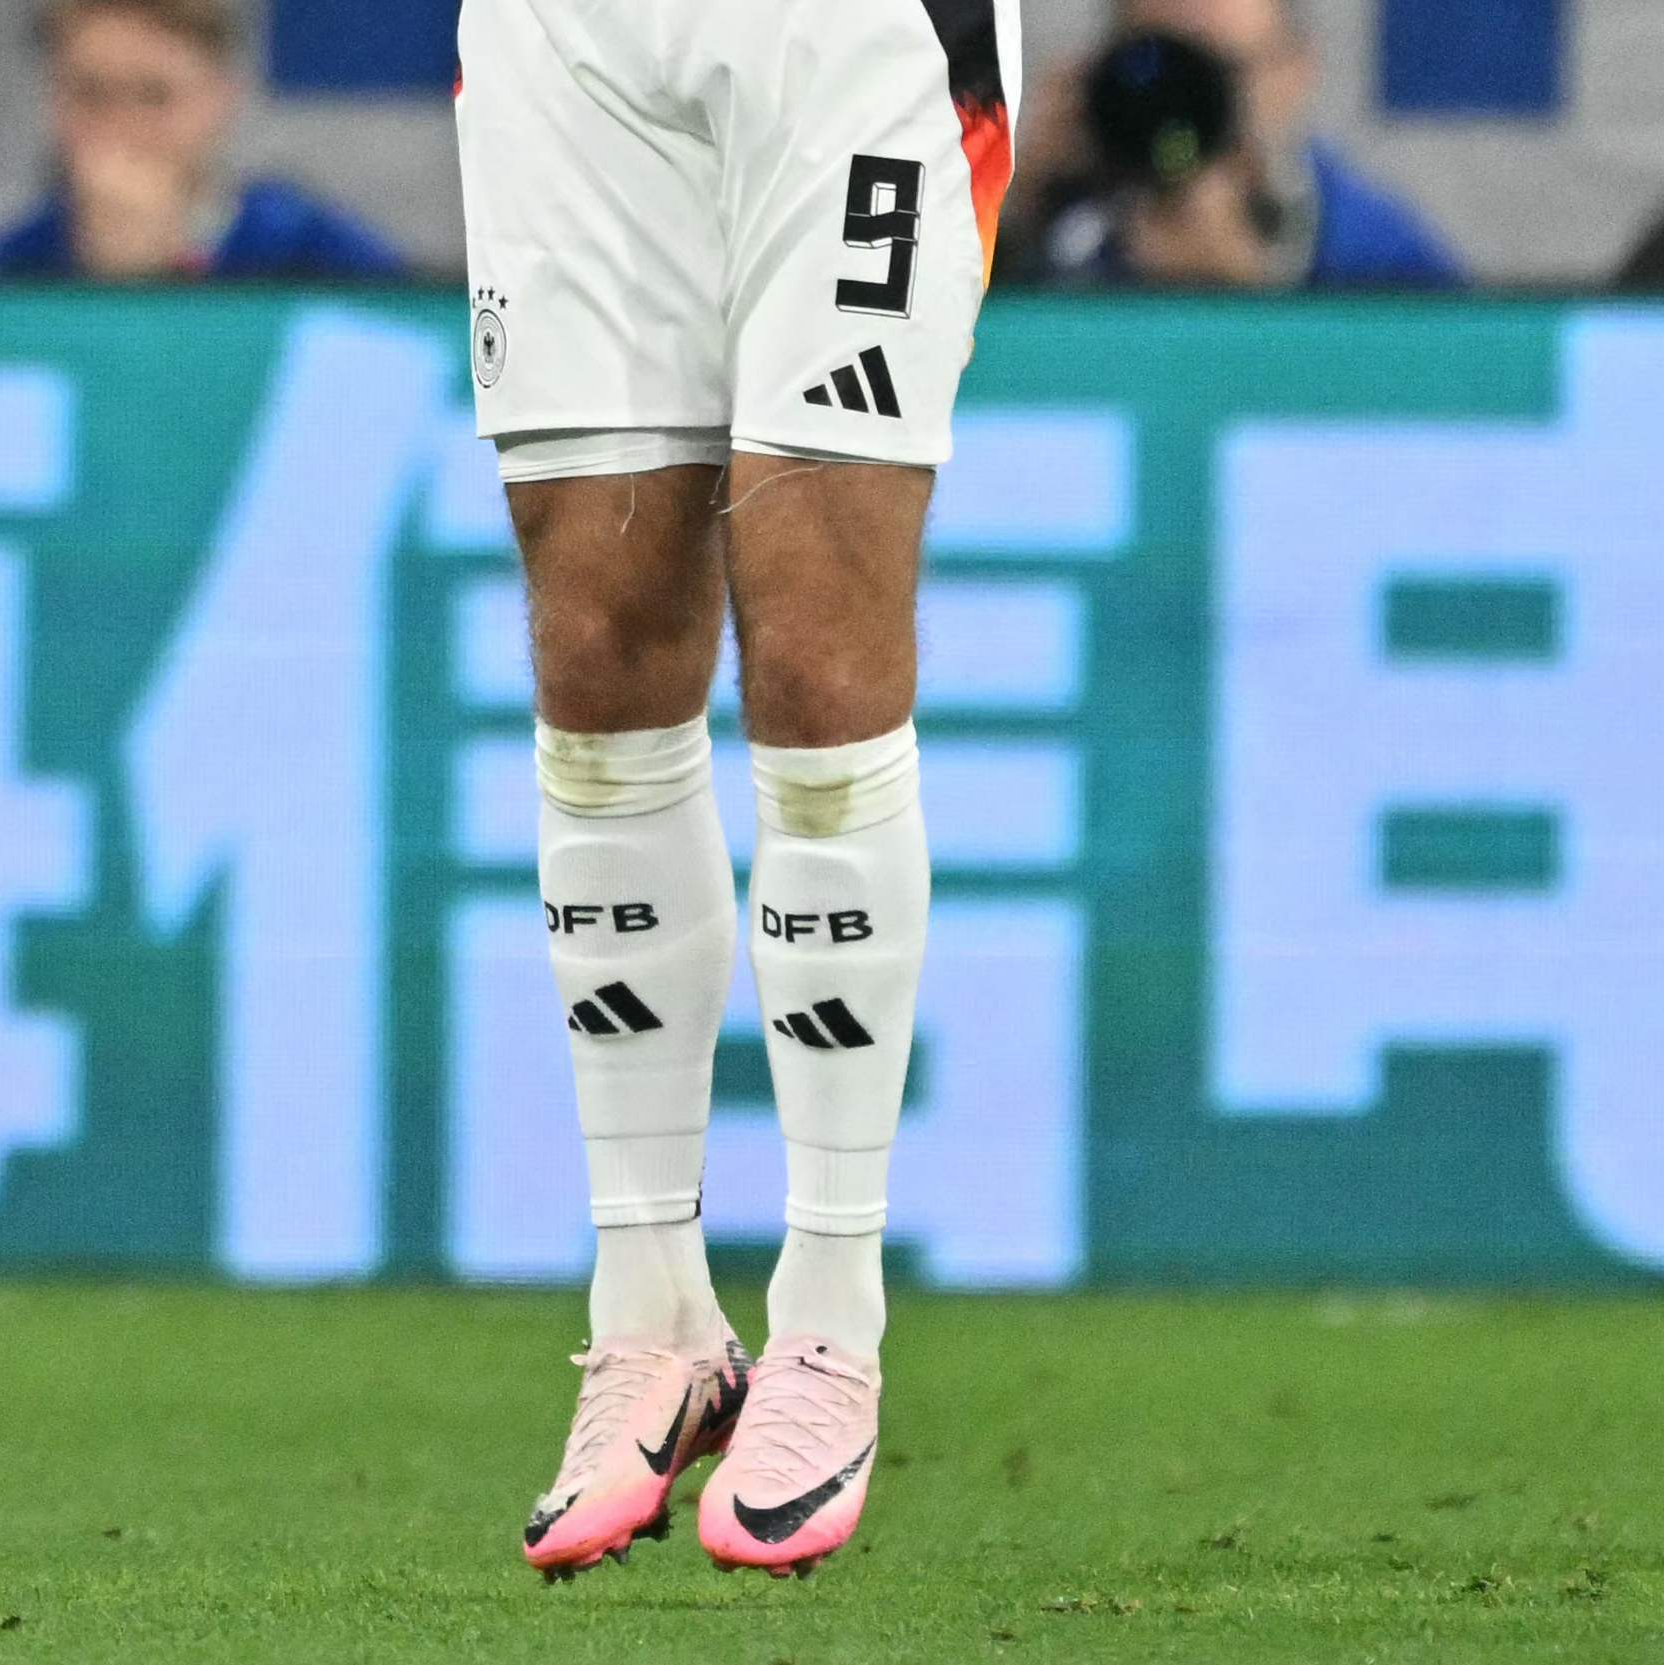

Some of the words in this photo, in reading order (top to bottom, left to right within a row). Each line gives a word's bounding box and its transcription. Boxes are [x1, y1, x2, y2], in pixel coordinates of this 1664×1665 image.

[835, 154, 926, 319] 9
[544, 901, 660, 933] DFB
[762, 904, 874, 943] DFB
